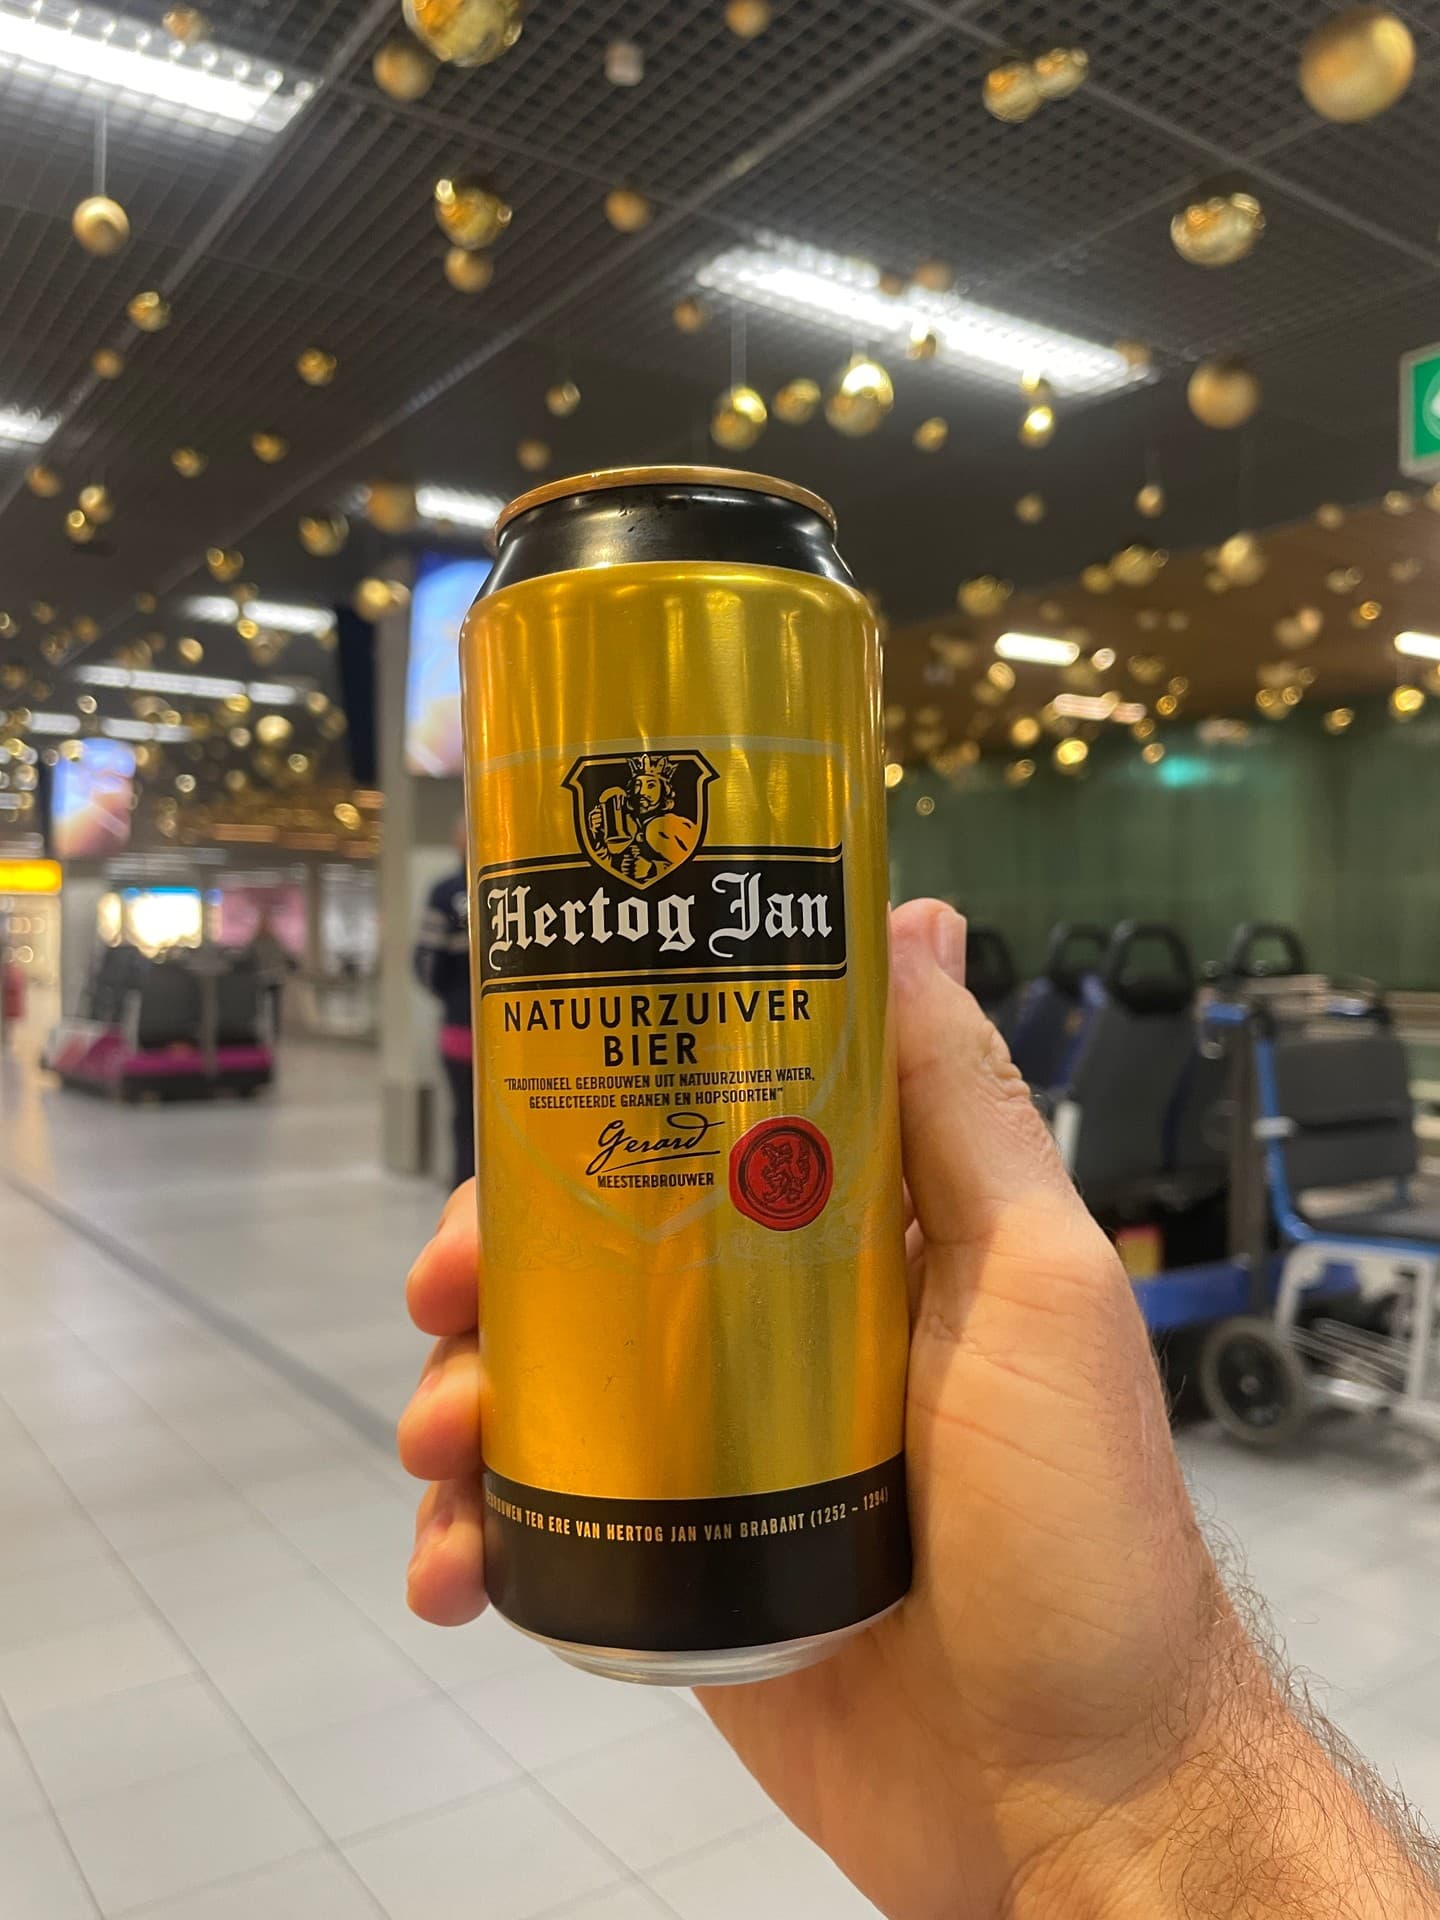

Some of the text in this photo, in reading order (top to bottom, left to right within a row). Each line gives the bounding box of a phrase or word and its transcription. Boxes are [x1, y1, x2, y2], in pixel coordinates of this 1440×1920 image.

[487, 872, 833, 971] Hertog Jan
[504, 989, 811, 1032] NATUURZUIVER
[603, 1032, 698, 1067] BIER
[576, 1074, 650, 1090] GEBROUWEN
[655, 1073, 675, 1088] UIT
[679, 1069, 772, 1087] NATUURZUIVER
[776, 1066, 815, 1082] WATER,
[529, 1094, 616, 1109] GESELECTEERDE
[620, 1092, 670, 1108] GRANEN
[674, 1091, 691, 1106] EN
[586, 1111, 725, 1176] Gerard
[597, 1172, 715, 1189] MEESTERBROUWER
[525, 1509, 544, 1530] TER
[548, 1515, 570, 1535] ERE
[575, 1520, 600, 1539] VAN
[606, 1523, 663, 1543] HERTOG
[670, 1526, 696, 1543] JAN
[704, 1523, 732, 1541] VAN
[740, 1512, 805, 1538] BRABANT
[810, 1503, 846, 1528] (1252
